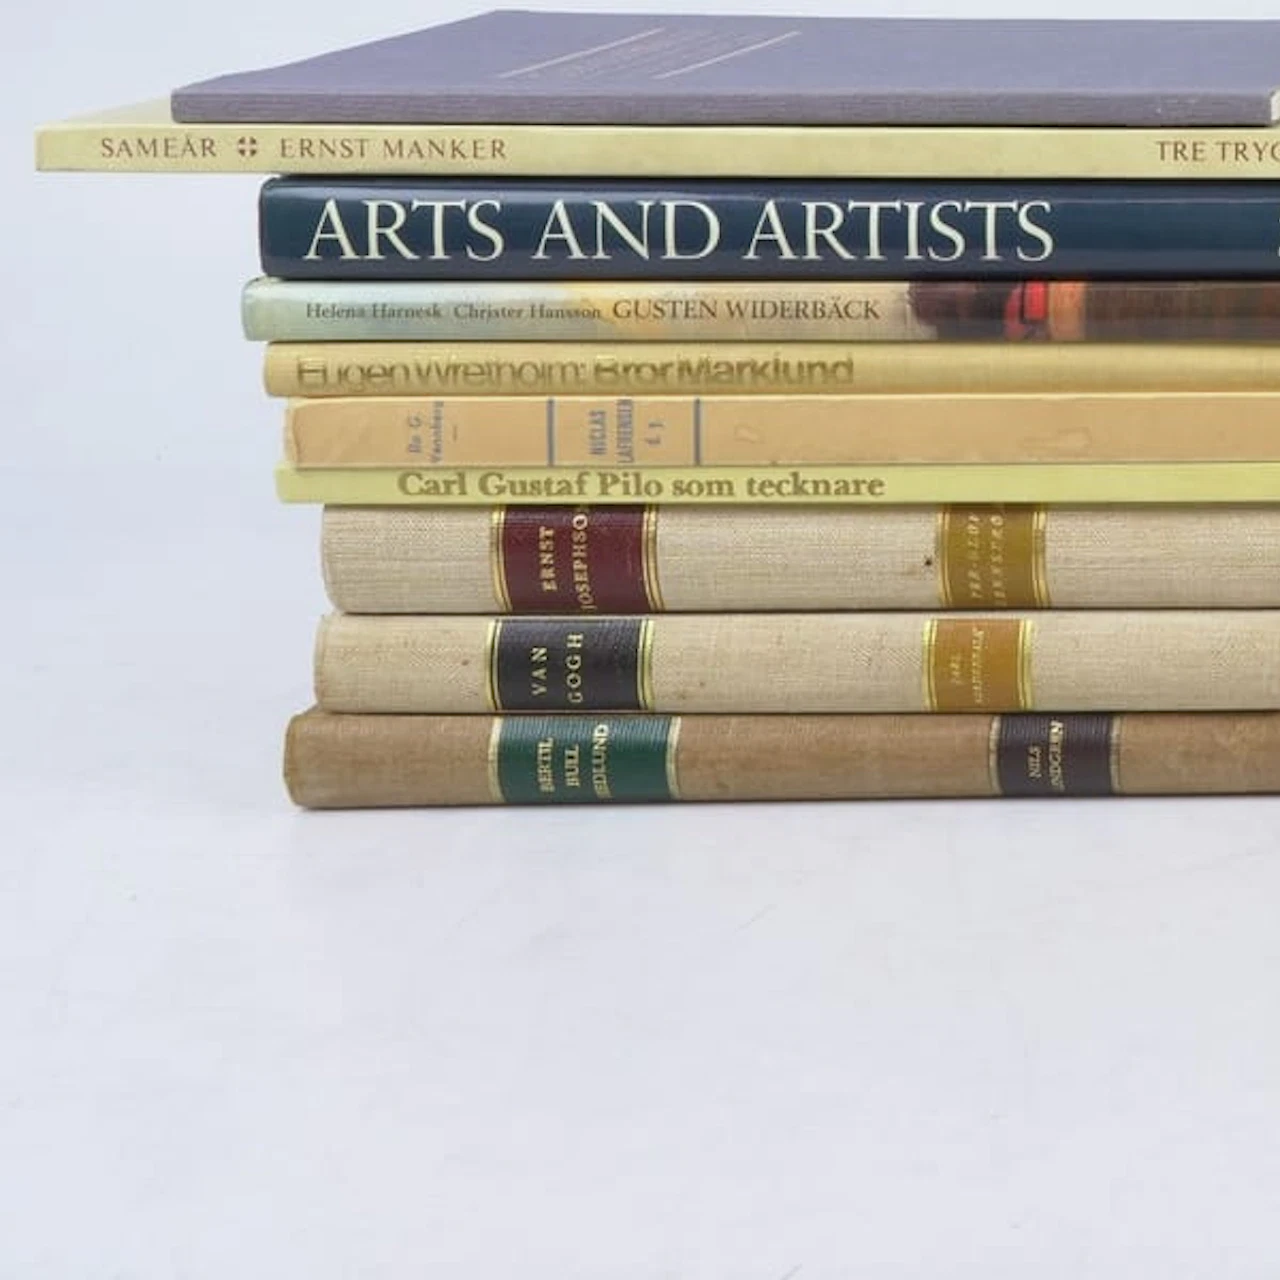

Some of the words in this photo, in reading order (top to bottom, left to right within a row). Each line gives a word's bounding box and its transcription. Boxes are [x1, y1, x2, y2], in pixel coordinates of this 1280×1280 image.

[101, 135, 218, 159] SAMEÅR
[280, 138, 370, 159] ERNST
[382, 138, 508, 160] MANKER
[1156, 140, 1207, 162] TRE
[302, 198, 505, 262] ARTS
[530, 198, 721, 262] AND
[743, 198, 1055, 262] ARTISTS
[305, 302, 365, 321] Helena
[371, 302, 443, 320] Harnesk
[453, 302, 519, 322] Christer
[521, 303, 601, 321] Hansson
[612, 299, 719, 320] GUSTEN
[725, 299, 881, 320] WIDERBÄCK
[296, 356, 411, 391] Eugen
[593, 354, 674, 385] Bror
[676, 351, 856, 385] Marklund
[397, 472, 468, 497] Carl
[477, 472, 588, 497] Gustaf
[598, 472, 664, 497] Pilo
[672, 478, 735, 497] som
[746, 472, 886, 497] tecknare
[539, 525, 557, 592] ERNST
[530, 645, 548, 697] VAN
[564, 632, 584, 704] GOGH
